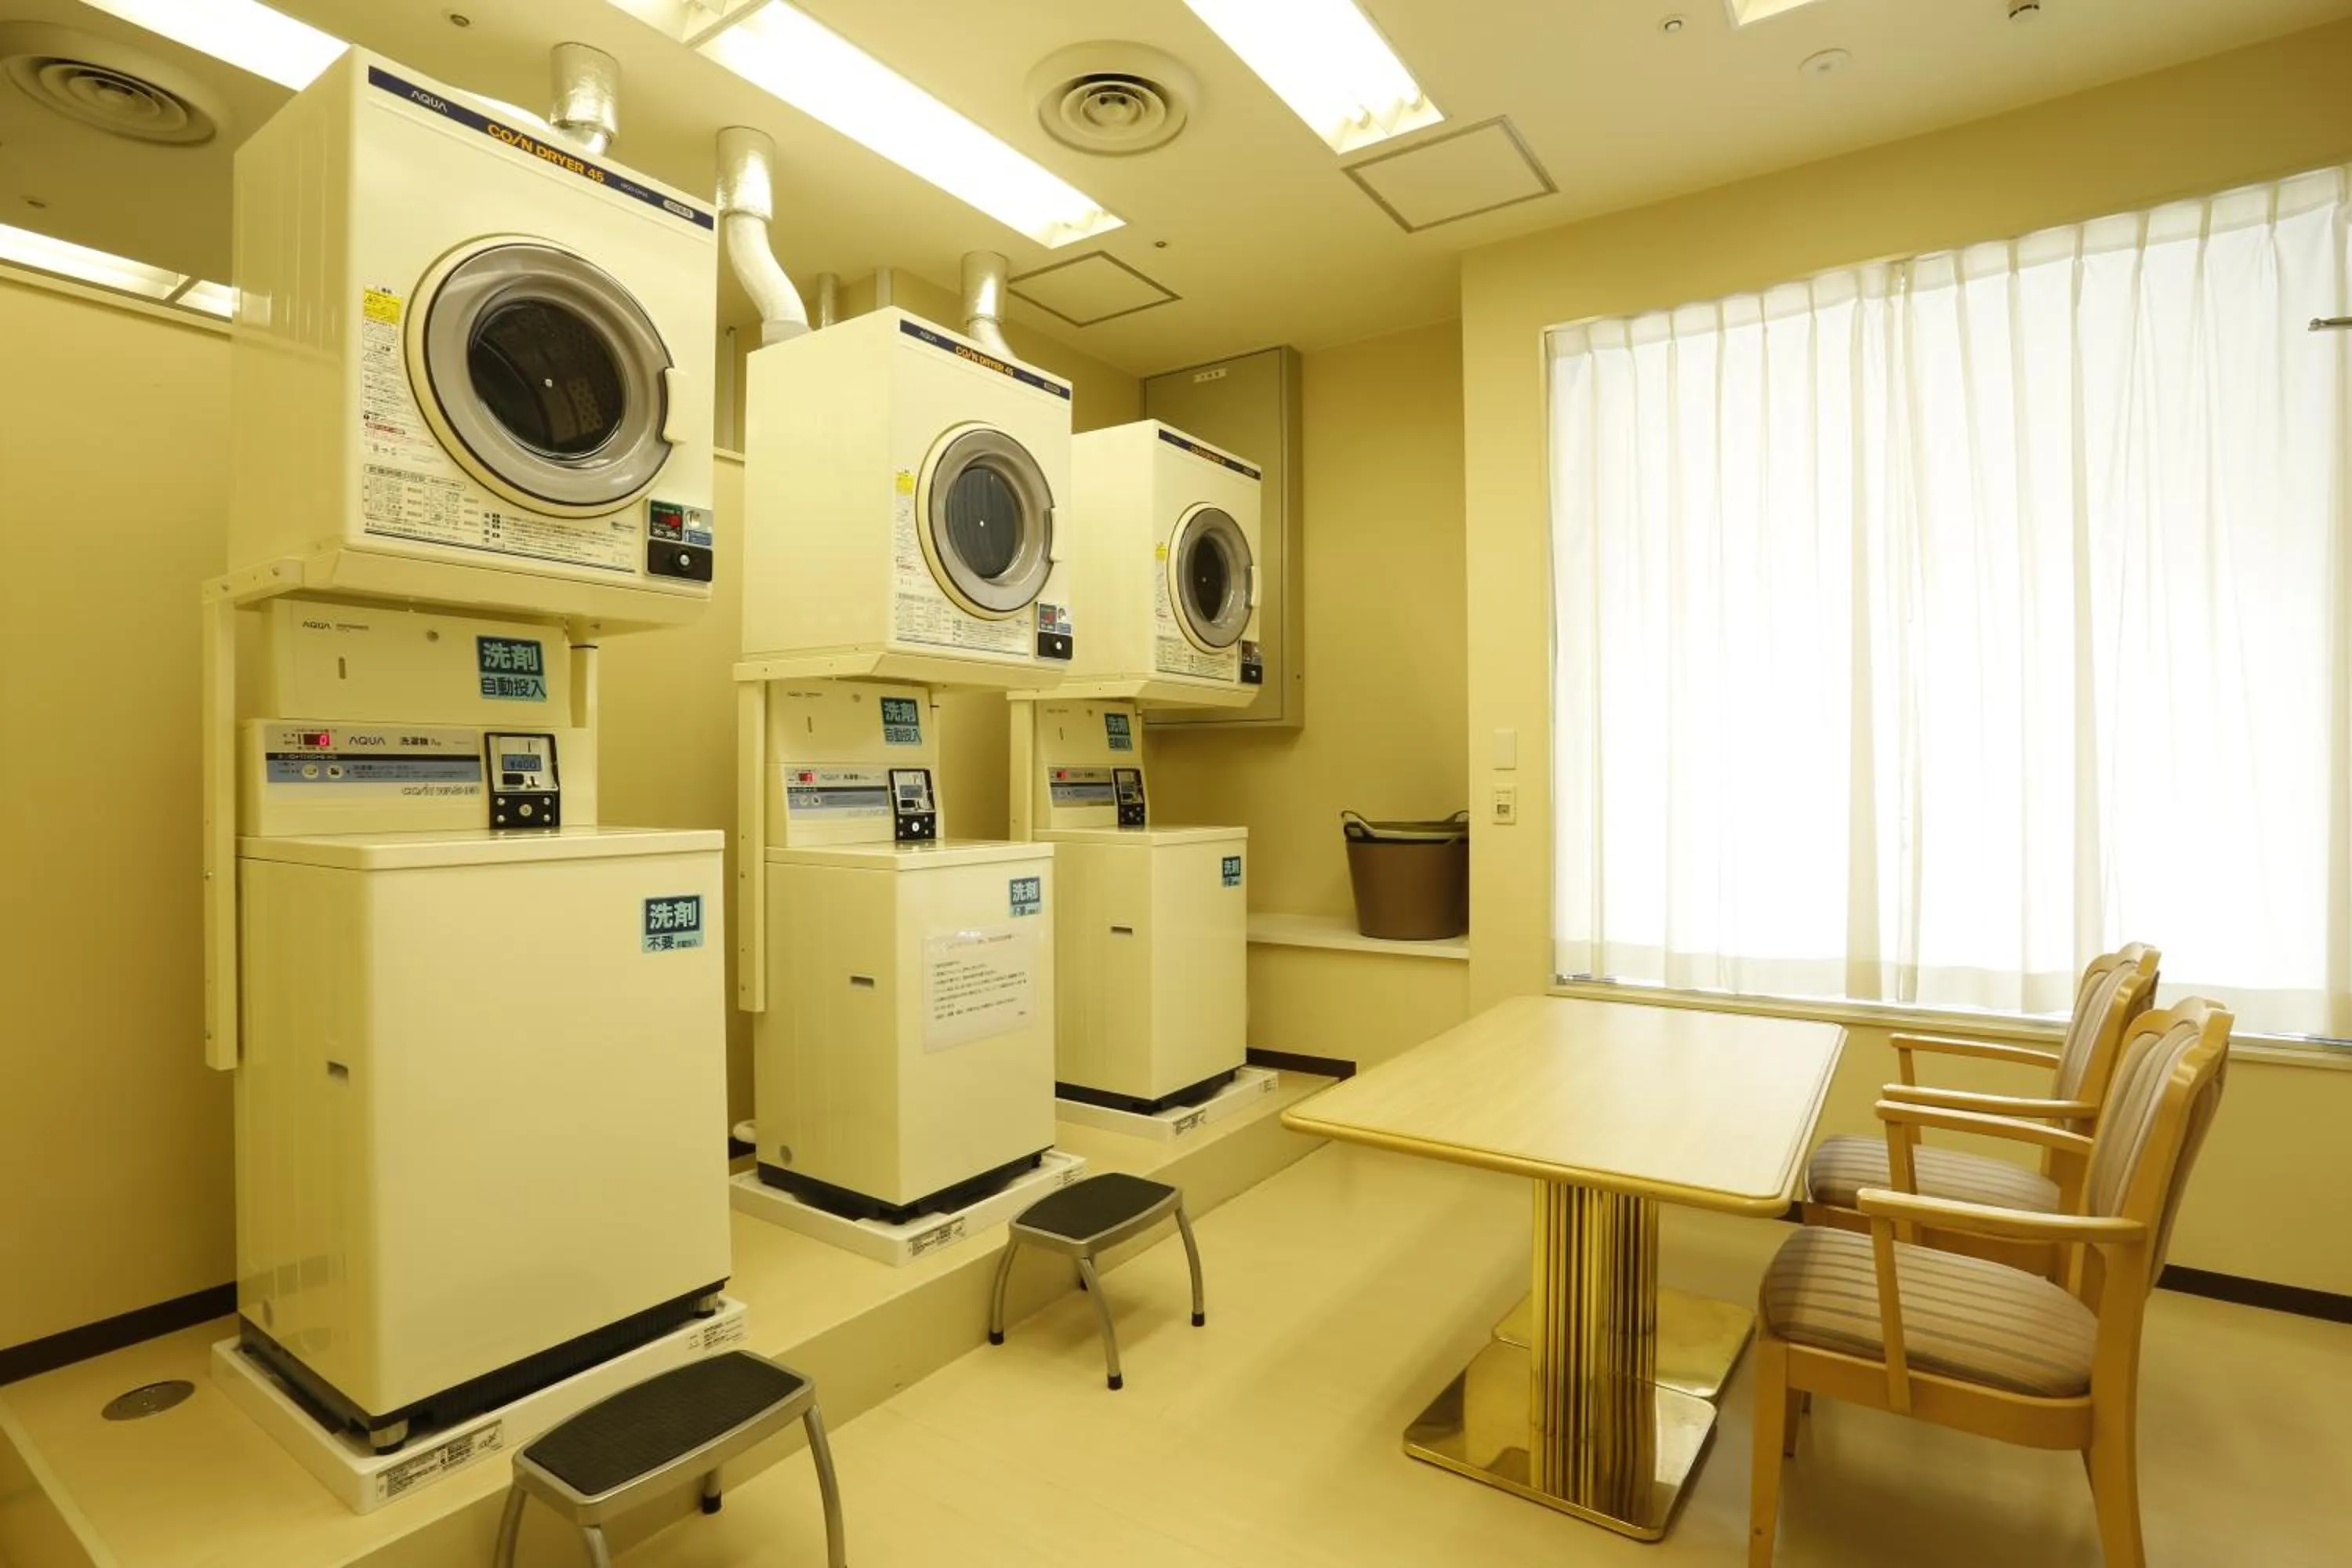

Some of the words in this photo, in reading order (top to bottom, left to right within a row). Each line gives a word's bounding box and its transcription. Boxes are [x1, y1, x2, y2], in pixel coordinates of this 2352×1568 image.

[411, 90, 448, 114] AQUA
[535, 144, 585, 176] DRYER
[586, 167, 604, 184] 45
[302, 620, 331, 630] AQUA
[483, 642, 539, 671] 洗剤
[481, 677, 546, 698] 自動投入
[319, 735, 327, 746] 0
[349, 736, 386, 746] AQUA
[649, 901, 697, 929] 洗剤
[647, 935, 674, 951] 不要
